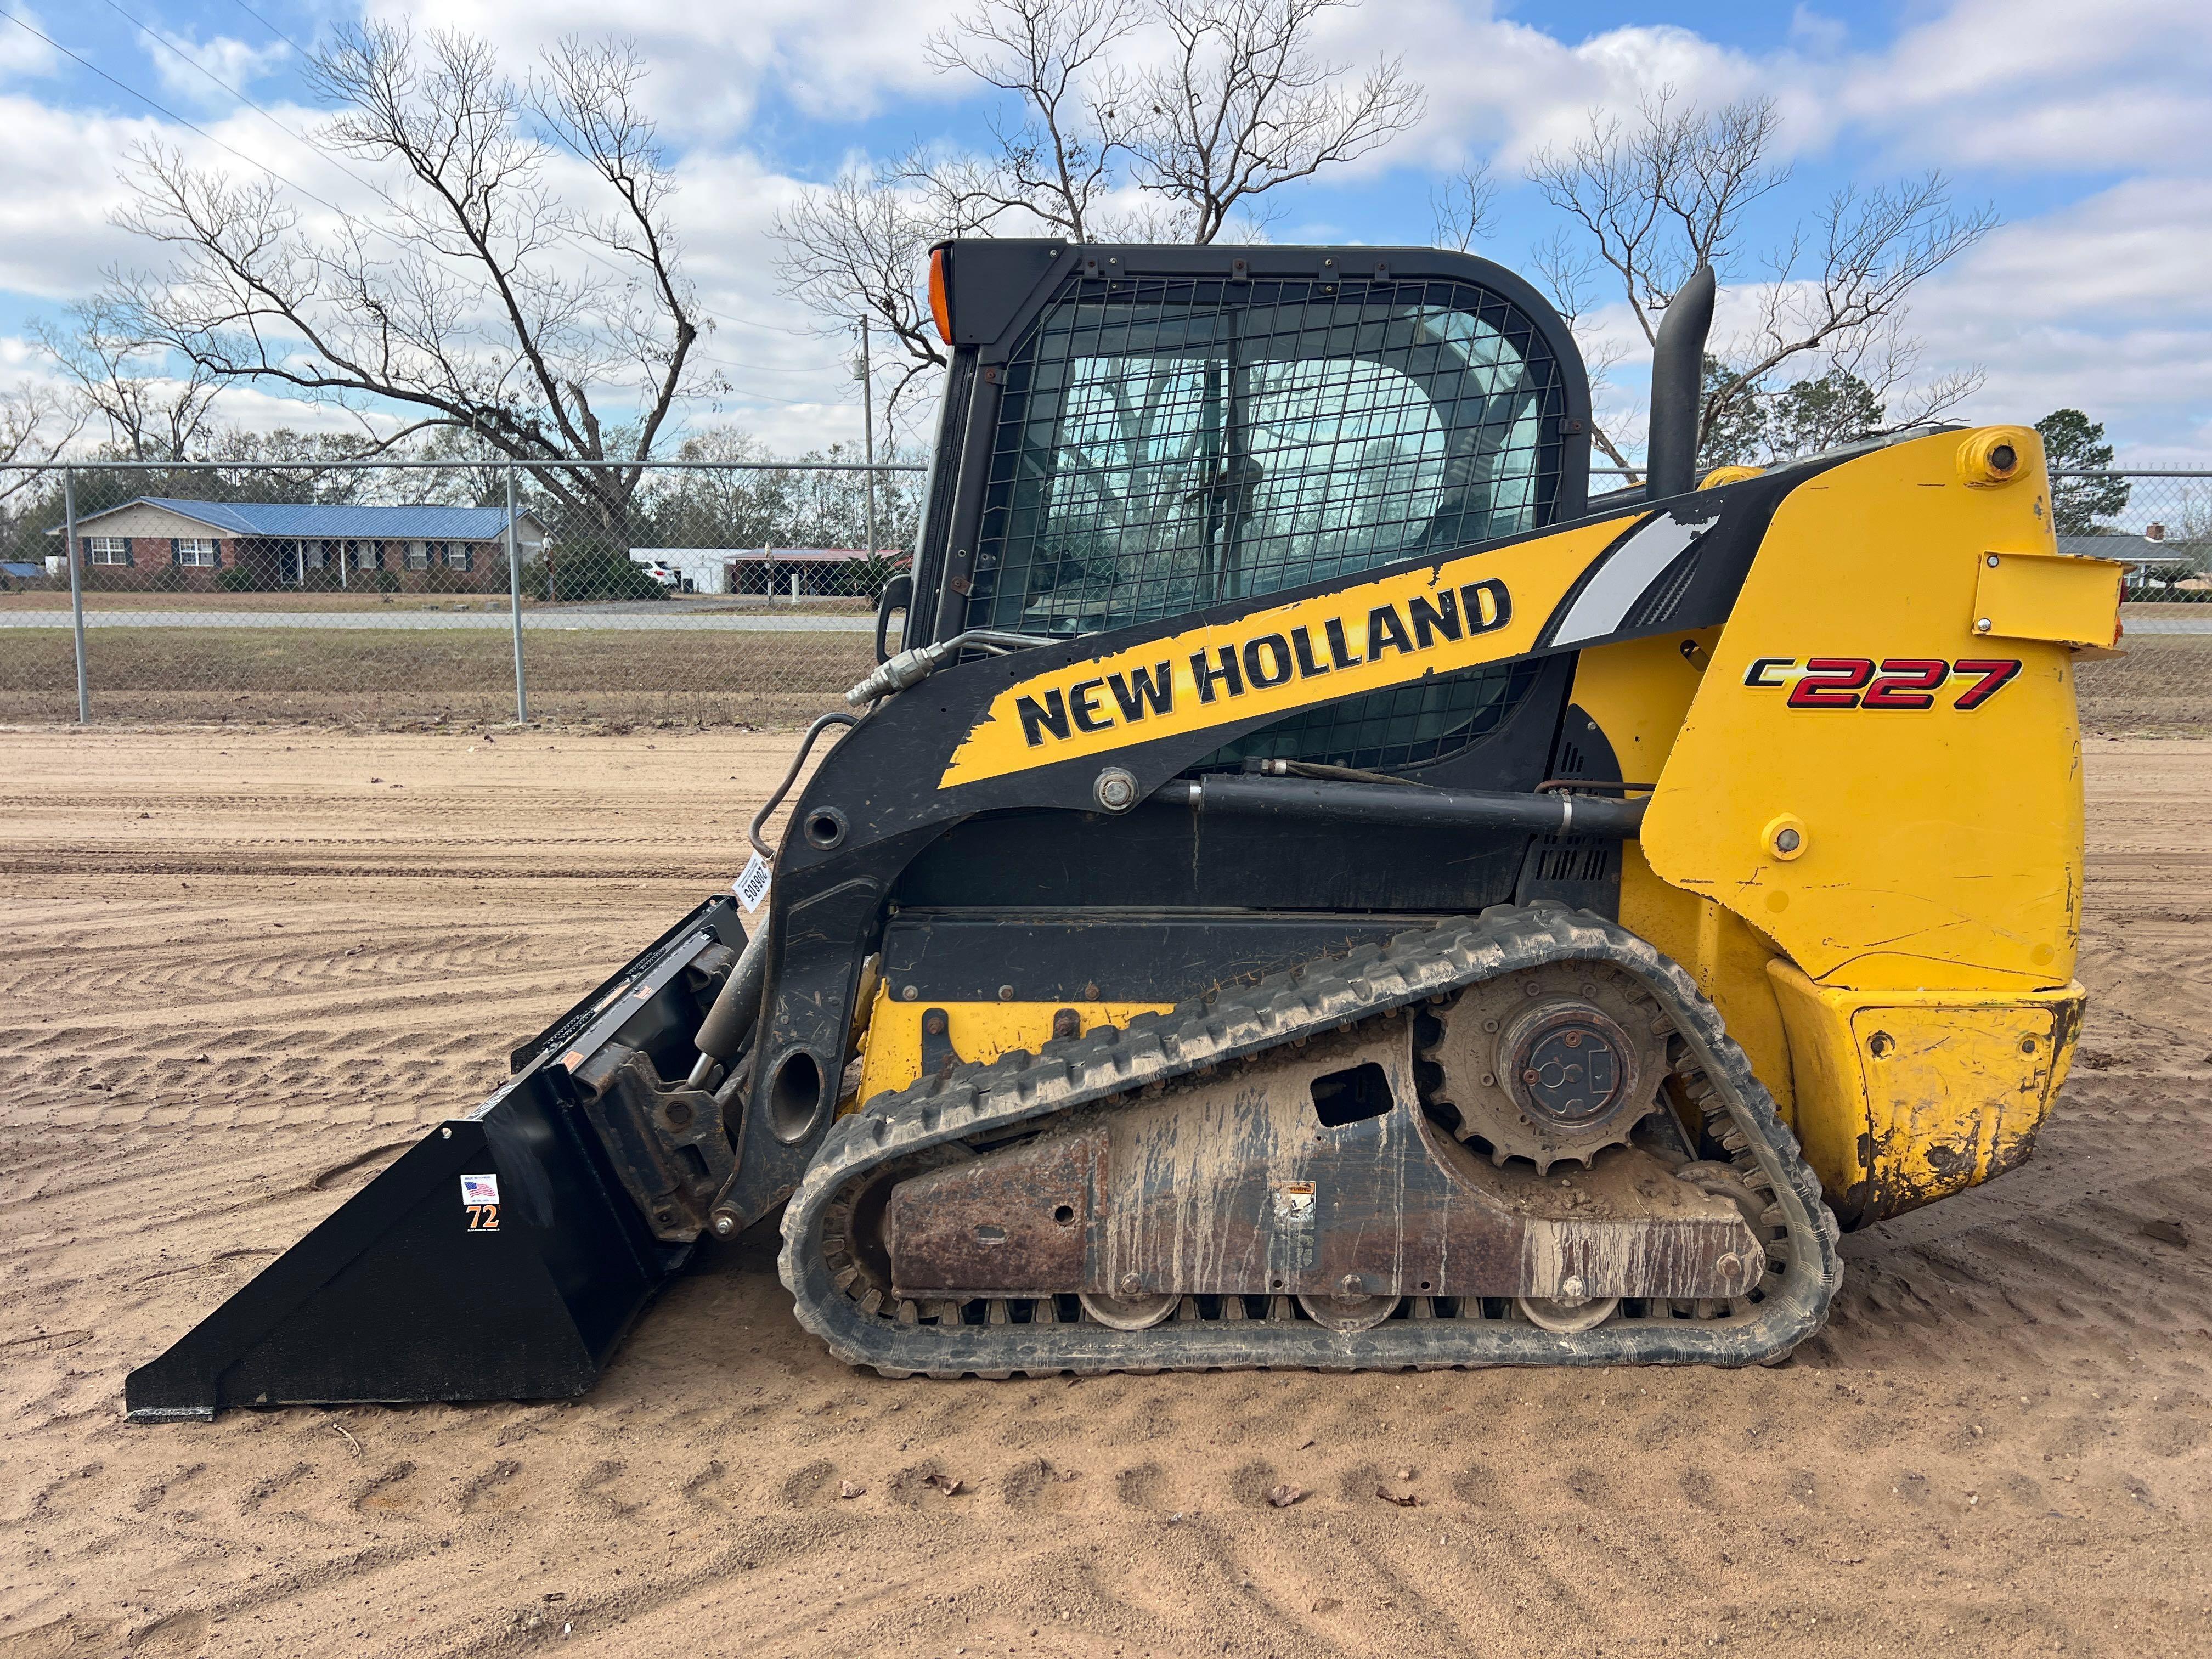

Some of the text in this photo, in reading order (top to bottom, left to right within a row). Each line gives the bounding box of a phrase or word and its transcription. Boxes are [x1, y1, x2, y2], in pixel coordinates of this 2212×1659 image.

[1016, 578, 1512, 748] NEW HOLLAND
[1743, 658, 2023, 710] C227
[744, 866, 768, 902] 206805
